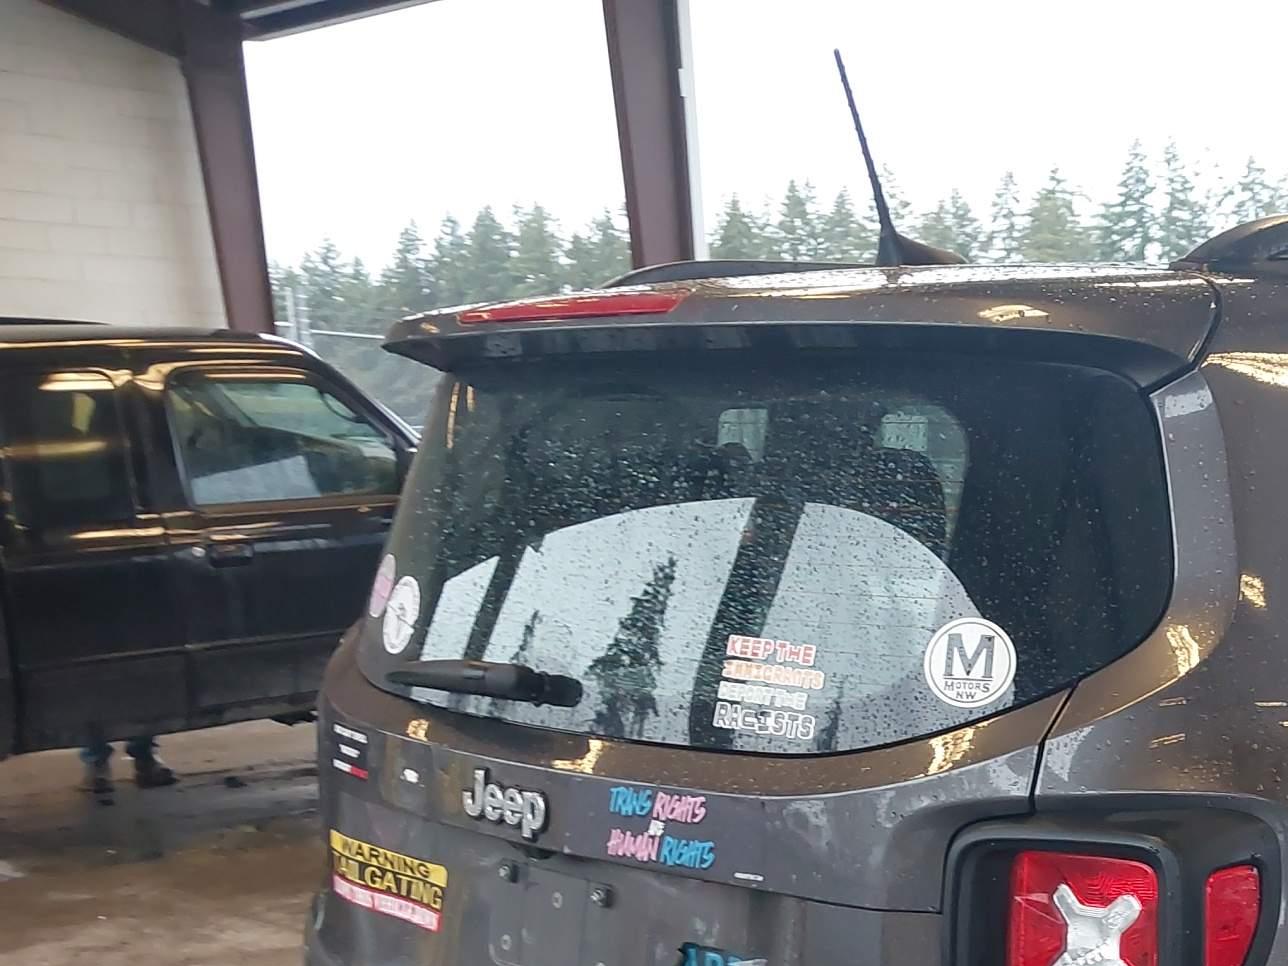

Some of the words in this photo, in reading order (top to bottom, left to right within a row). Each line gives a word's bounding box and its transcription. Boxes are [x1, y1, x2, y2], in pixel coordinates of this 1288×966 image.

[727, 634, 774, 659] KEEP
[776, 640, 816, 666] THE
[944, 633, 995, 678] M
[722, 659, 824, 689] IMMIGRANTS
[943, 680, 991, 693] MOTORS
[717, 680, 774, 706] DEPORT
[774, 687, 808, 710] THE
[955, 691, 977, 699] NW
[712, 701, 815, 739] RACISTS
[462, 769, 546, 838] Jeep
[609, 786, 652, 816] TRANS
[652, 791, 706, 823] RIGHTS
[341, 840, 431, 878] WARNING
[607, 828, 660, 861] HUMAN
[660, 836, 716, 869] RIGHTS
[332, 850, 443, 910] TAILGATING
